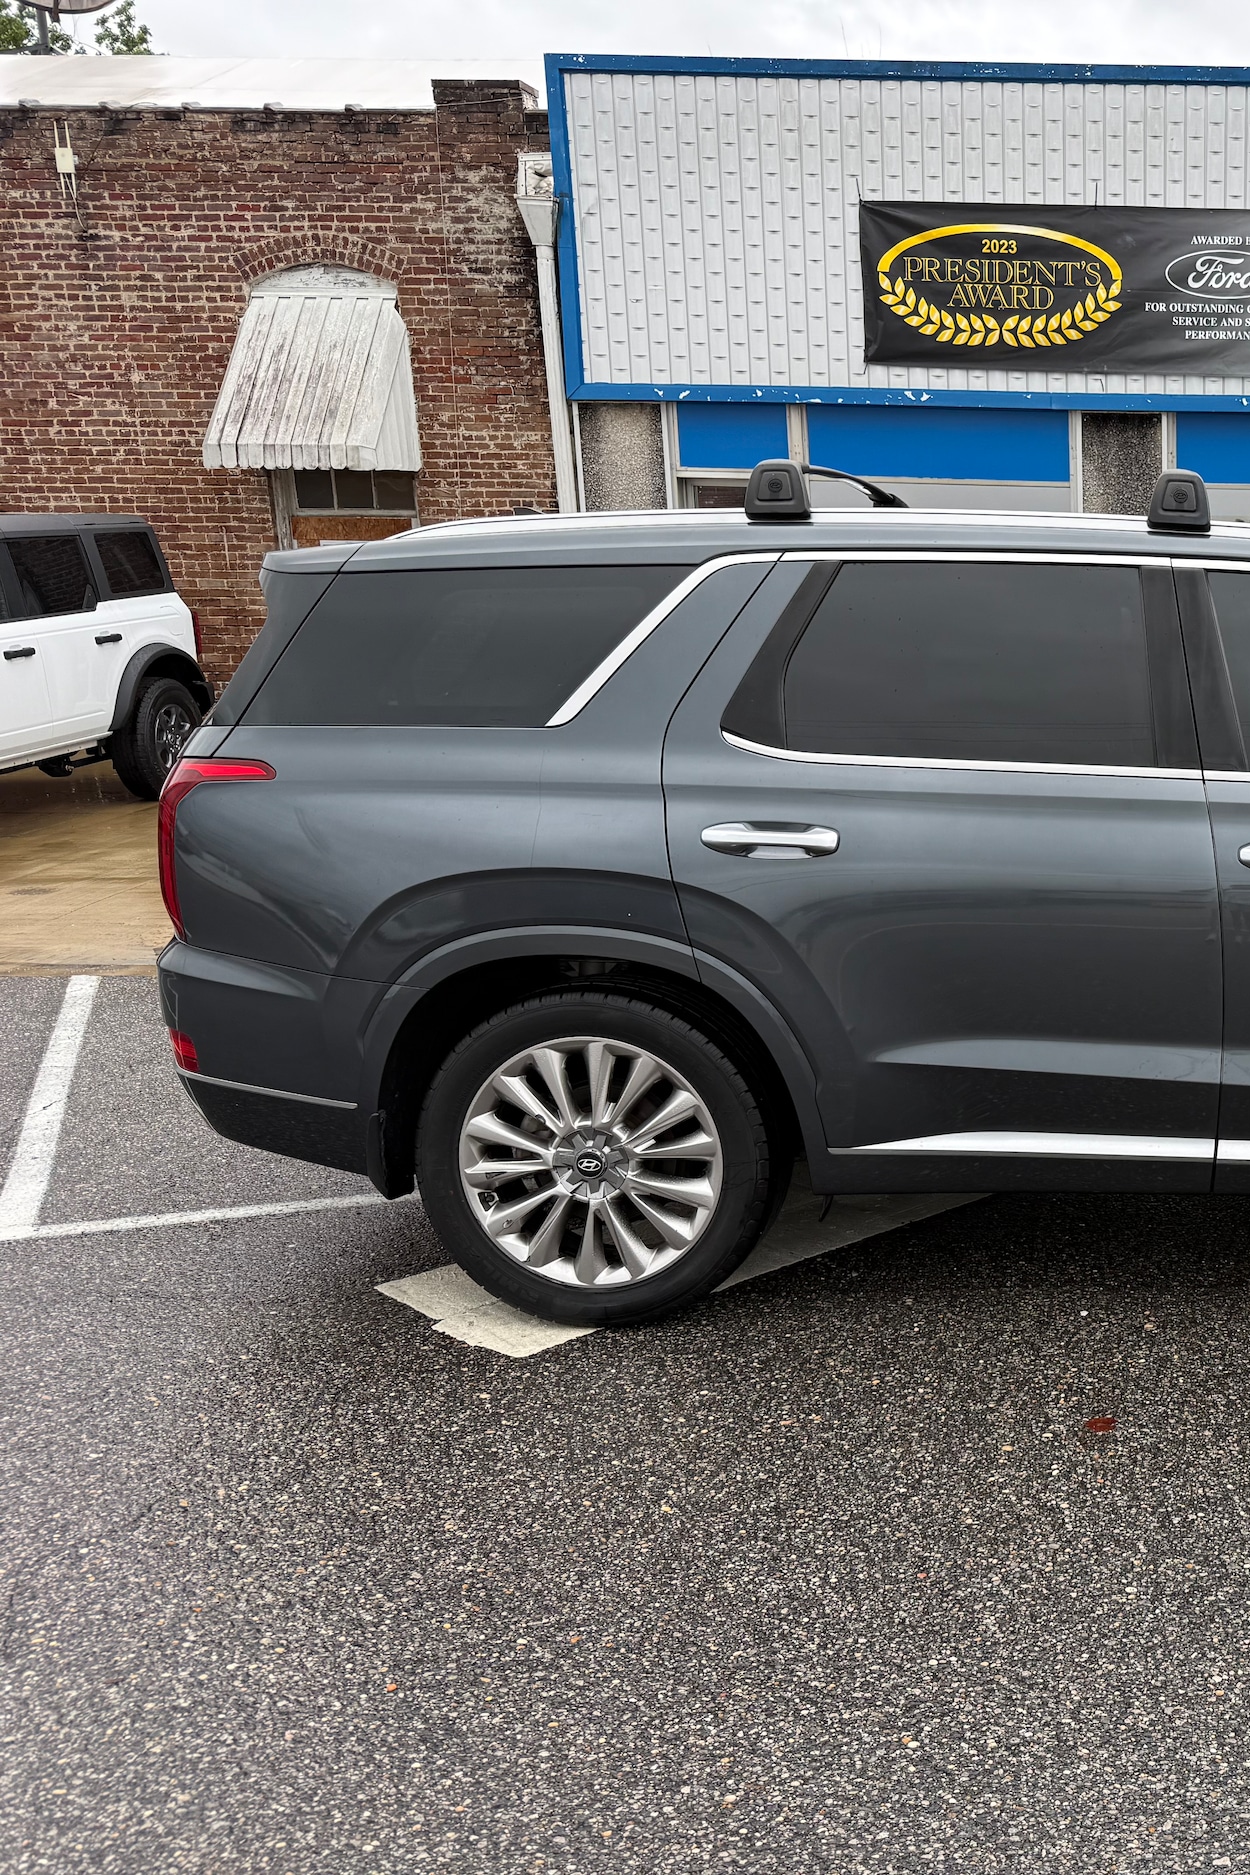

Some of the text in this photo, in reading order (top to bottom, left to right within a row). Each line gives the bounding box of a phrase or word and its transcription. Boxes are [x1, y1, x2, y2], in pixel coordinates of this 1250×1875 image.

[981, 239, 1017, 254] 2023
[1190, 235, 1243, 246] AWARDED
[903, 256, 1101, 287] PRESIDENT'S
[947, 284, 1055, 310] AWARD
[1145, 302, 1166, 313] FOR
[1169, 303, 1244, 315] OUTSTANDING
[1172, 316, 1217, 327] SERVICE
[1220, 317, 1243, 328] AND
